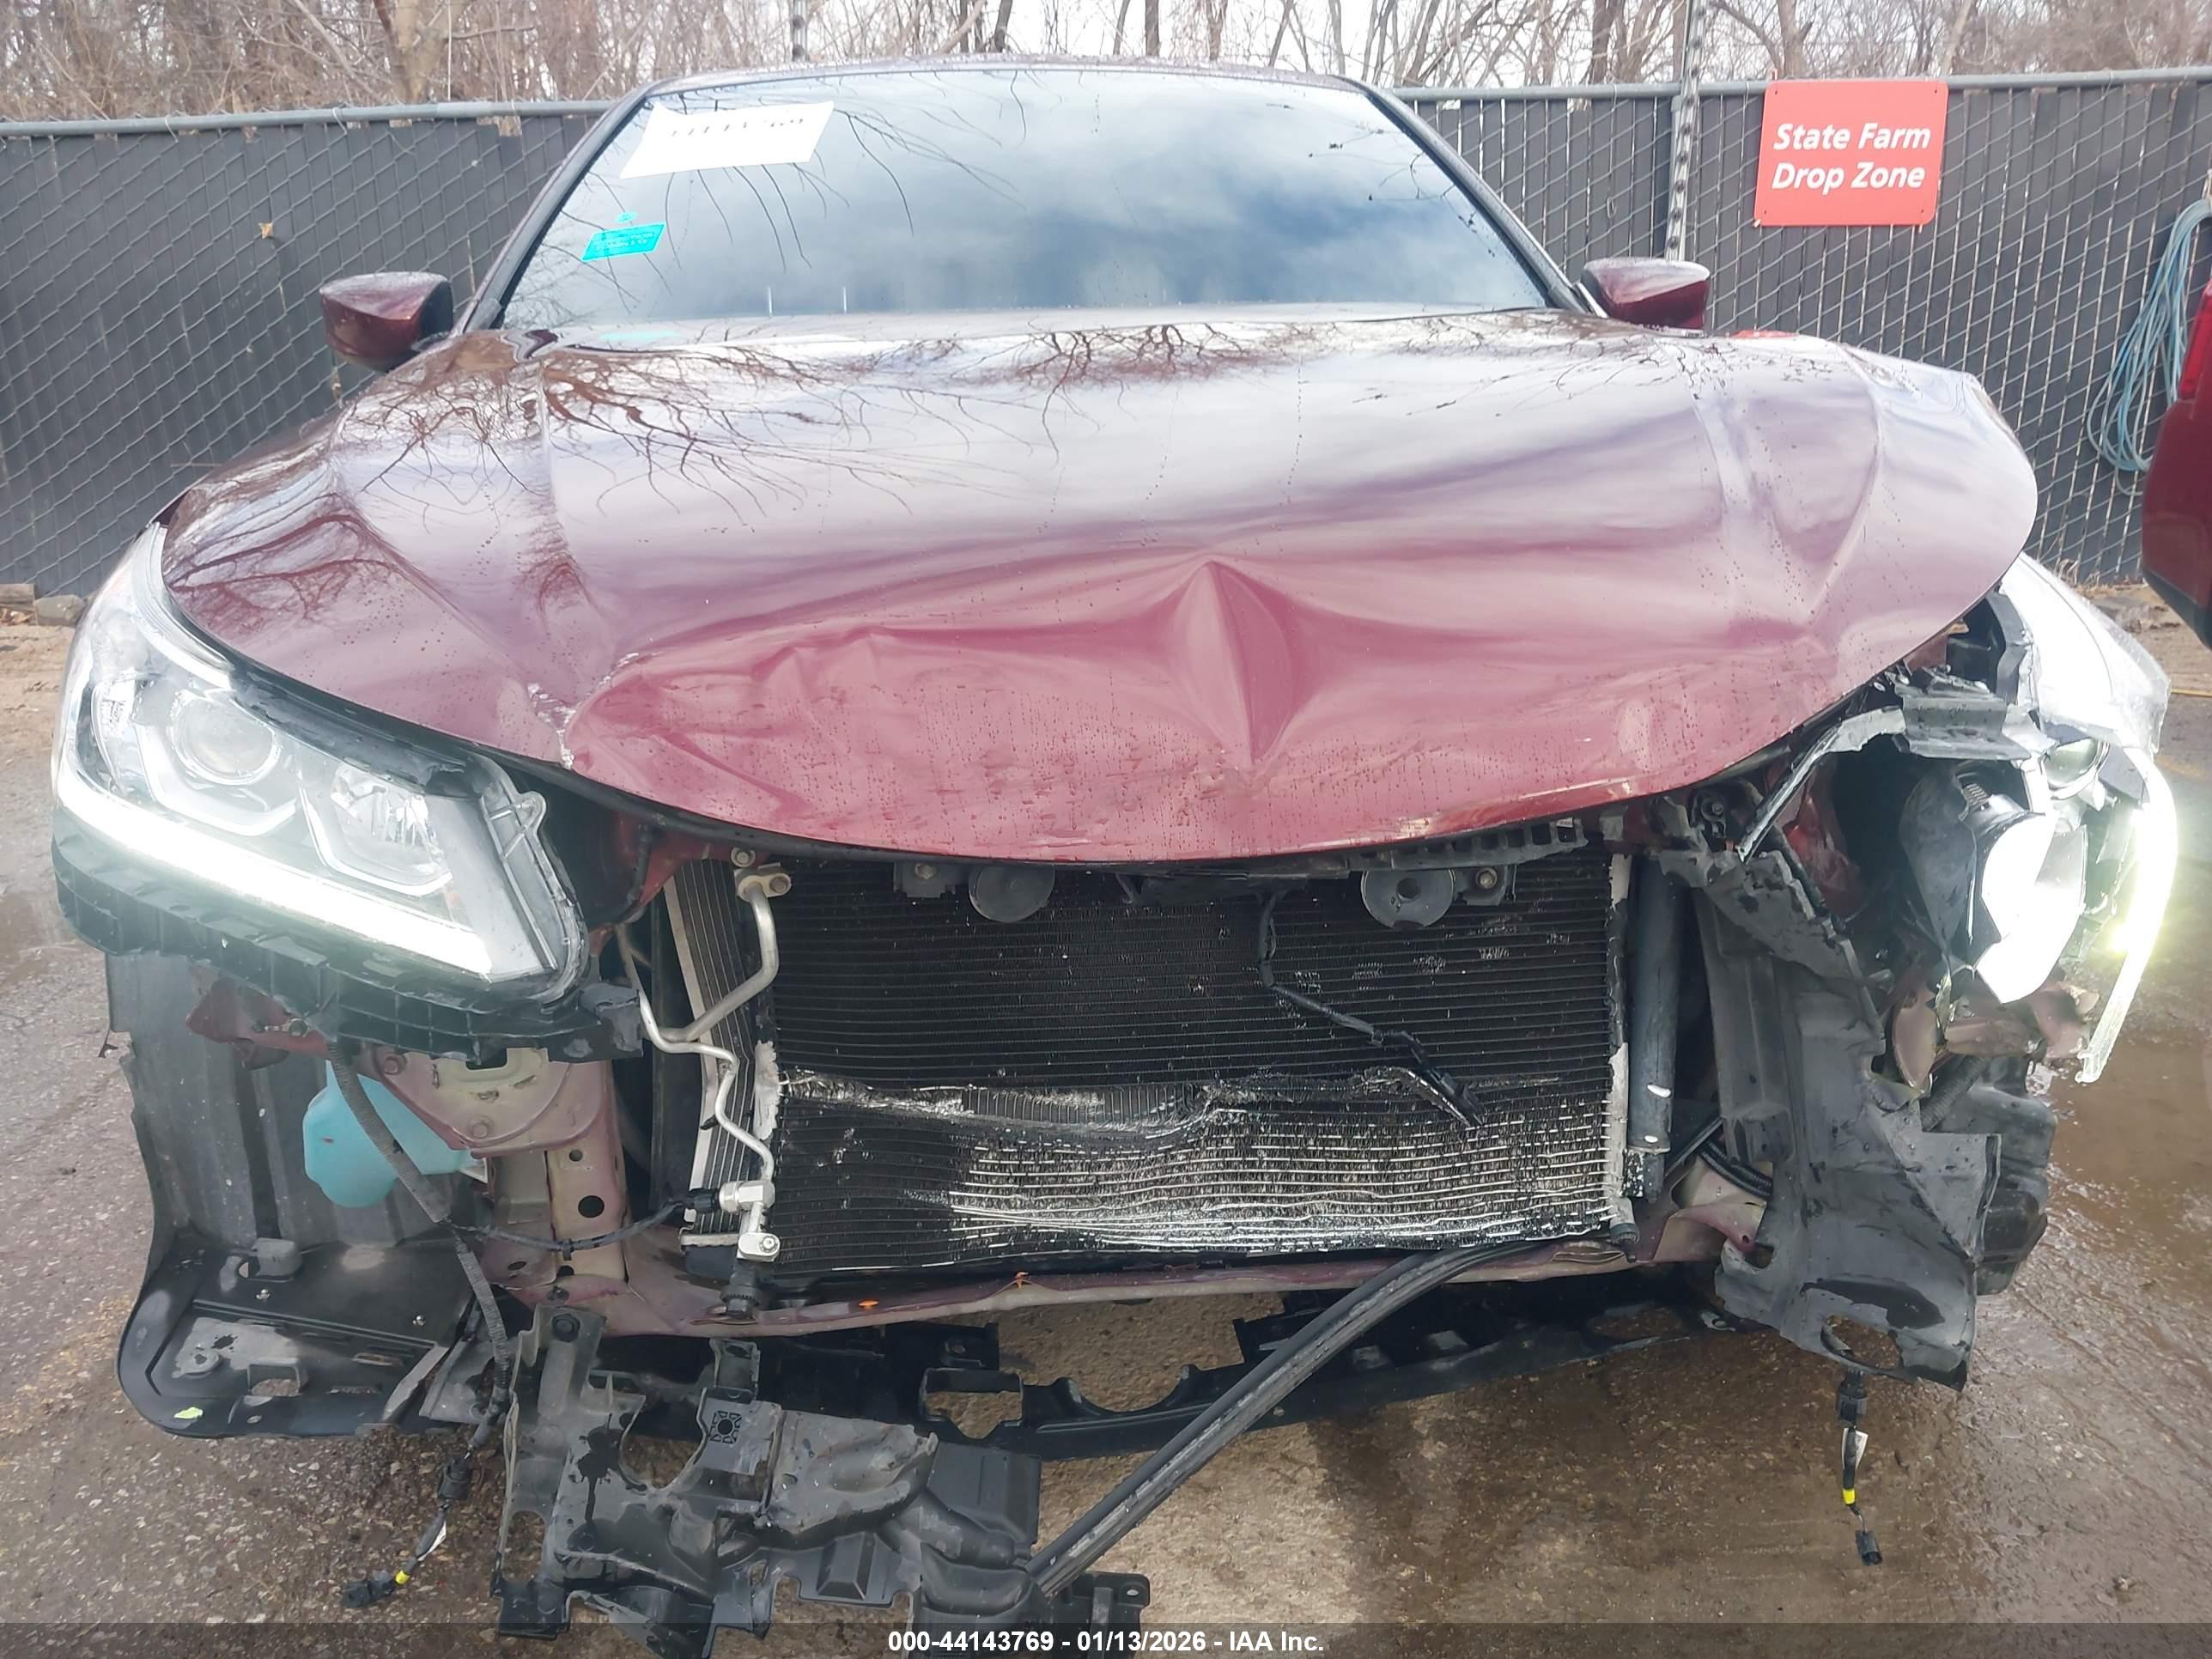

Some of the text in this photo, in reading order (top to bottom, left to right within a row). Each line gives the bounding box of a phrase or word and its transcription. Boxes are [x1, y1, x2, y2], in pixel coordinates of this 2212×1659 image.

[1772, 122, 1931, 150] State Farm
[1771, 161, 1926, 196] Drop Zone
